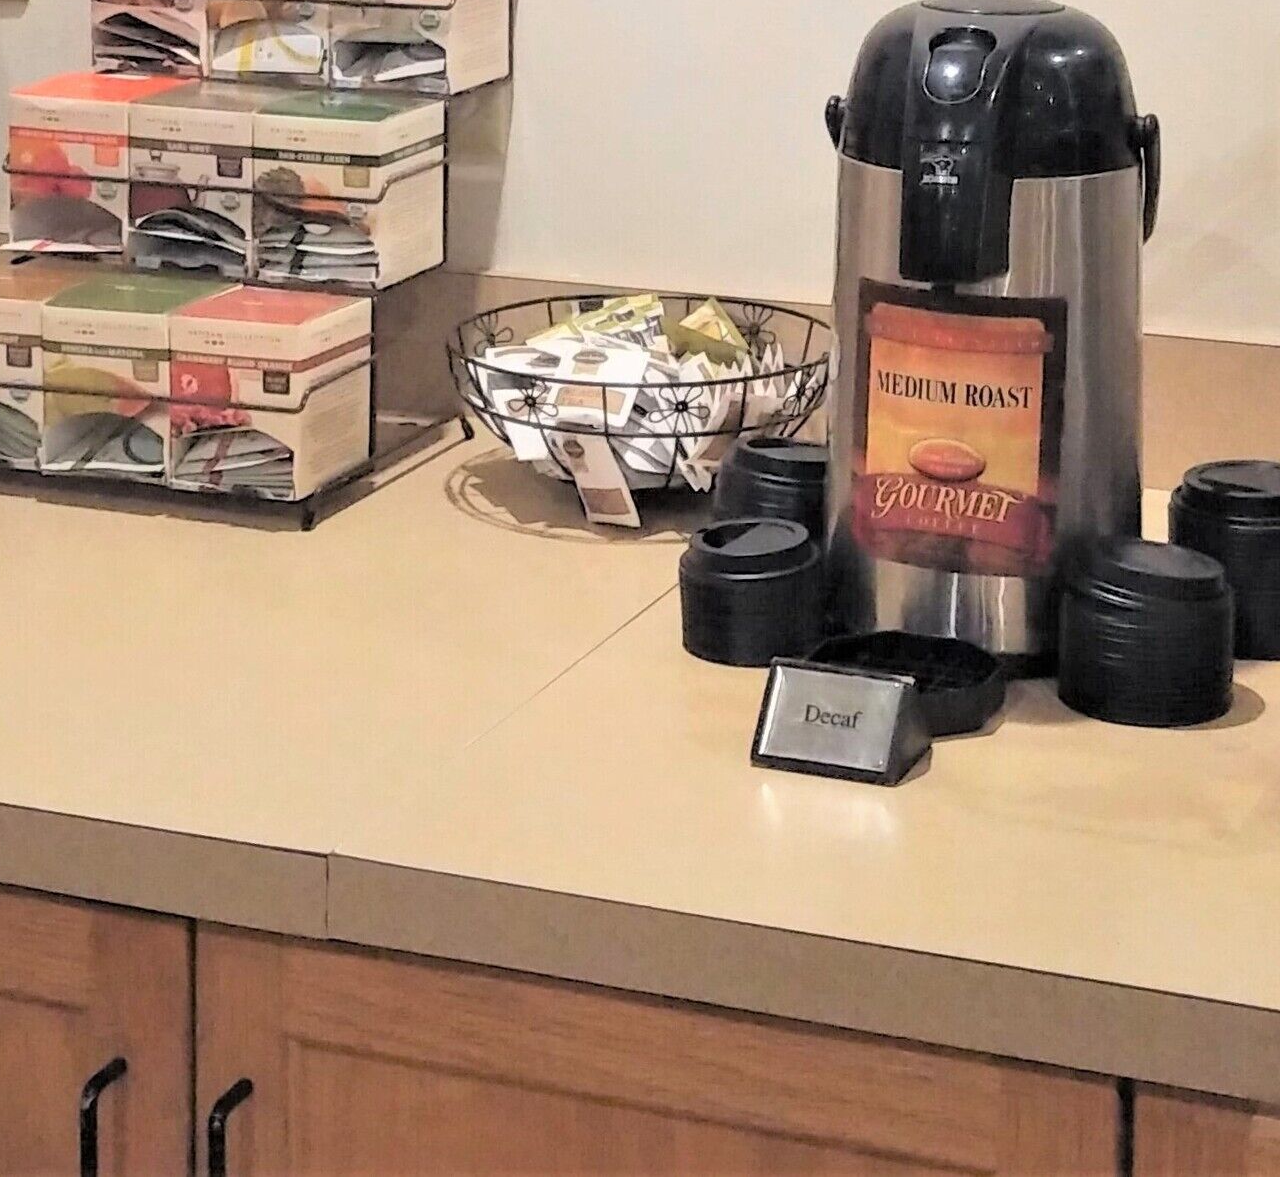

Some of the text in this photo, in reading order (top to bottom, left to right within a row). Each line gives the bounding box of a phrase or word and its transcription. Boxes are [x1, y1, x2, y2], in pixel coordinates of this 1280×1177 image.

[877, 369, 1033, 409] MEDIUM ROAST
[871, 476, 1024, 523] GOURMET
[804, 703, 864, 729] Decaf
